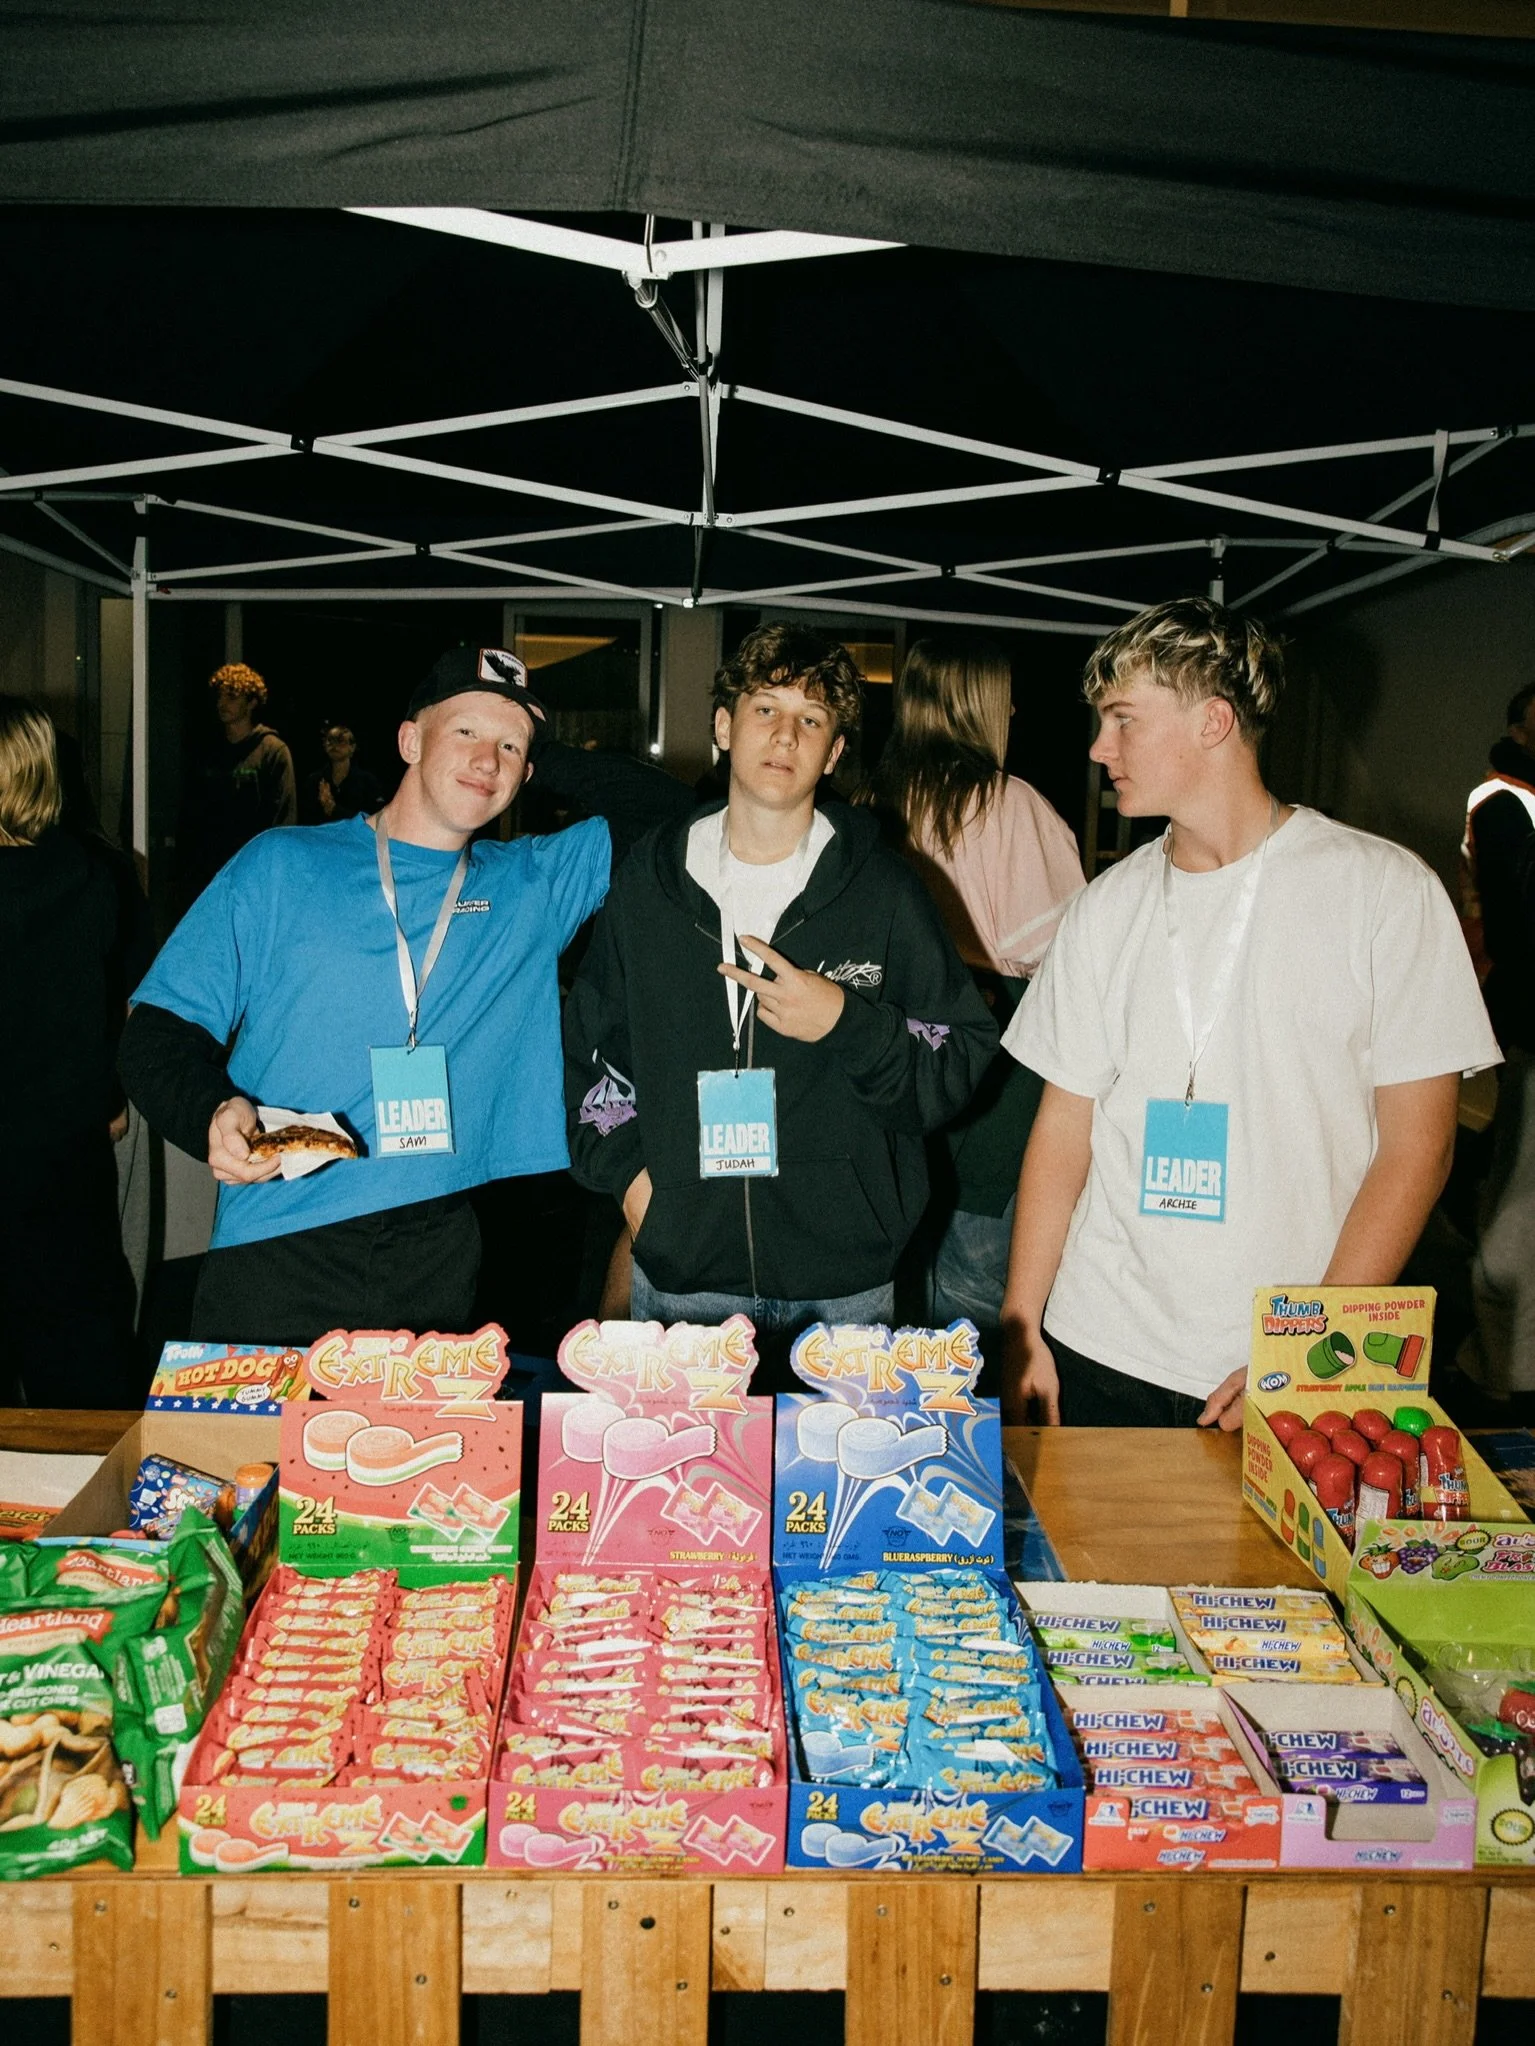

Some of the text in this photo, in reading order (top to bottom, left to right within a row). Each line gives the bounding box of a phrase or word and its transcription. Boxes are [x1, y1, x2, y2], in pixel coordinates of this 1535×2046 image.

[378, 1098, 447, 1134] LEADER
[399, 1136, 427, 1149] SAM
[703, 1122, 770, 1155] LEADER
[716, 1158, 755, 1171] JUDAH
[1145, 1156, 1221, 1196] LEADER
[1159, 1198, 1197, 1210] ARCHIE
[1271, 1295, 1322, 1317] THUMB
[1342, 1299, 1426, 1314] DIPPING POWDER
[1368, 1311, 1401, 1322] INSIDE
[1262, 1314, 1327, 1335] DIPPERS
[165, 1344, 204, 1361] Trolli
[565, 1320, 751, 1392] EXTREME
[797, 1323, 977, 1393] EXTREME
[177, 1356, 280, 1387] HOT DOG
[310, 1330, 501, 1400] EXTREME
[432, 1377, 497, 1421] Z
[683, 1369, 749, 1416] Z
[912, 1371, 979, 1416] Z
[293, 1496, 337, 1524] 24
[549, 1491, 592, 1520] 24
[787, 1491, 828, 1521] 24
[292, 1523, 337, 1535] PACKS
[548, 1520, 590, 1532] PACKS
[785, 1521, 827, 1533] PACKS
[668, 1551, 724, 1561] STRAWBERRY
[883, 1552, 954, 1563] BLUERASPBERRY
[195, 1794, 227, 1817] 24
[506, 1791, 537, 1814] 24
[807, 1790, 839, 1814] 24
